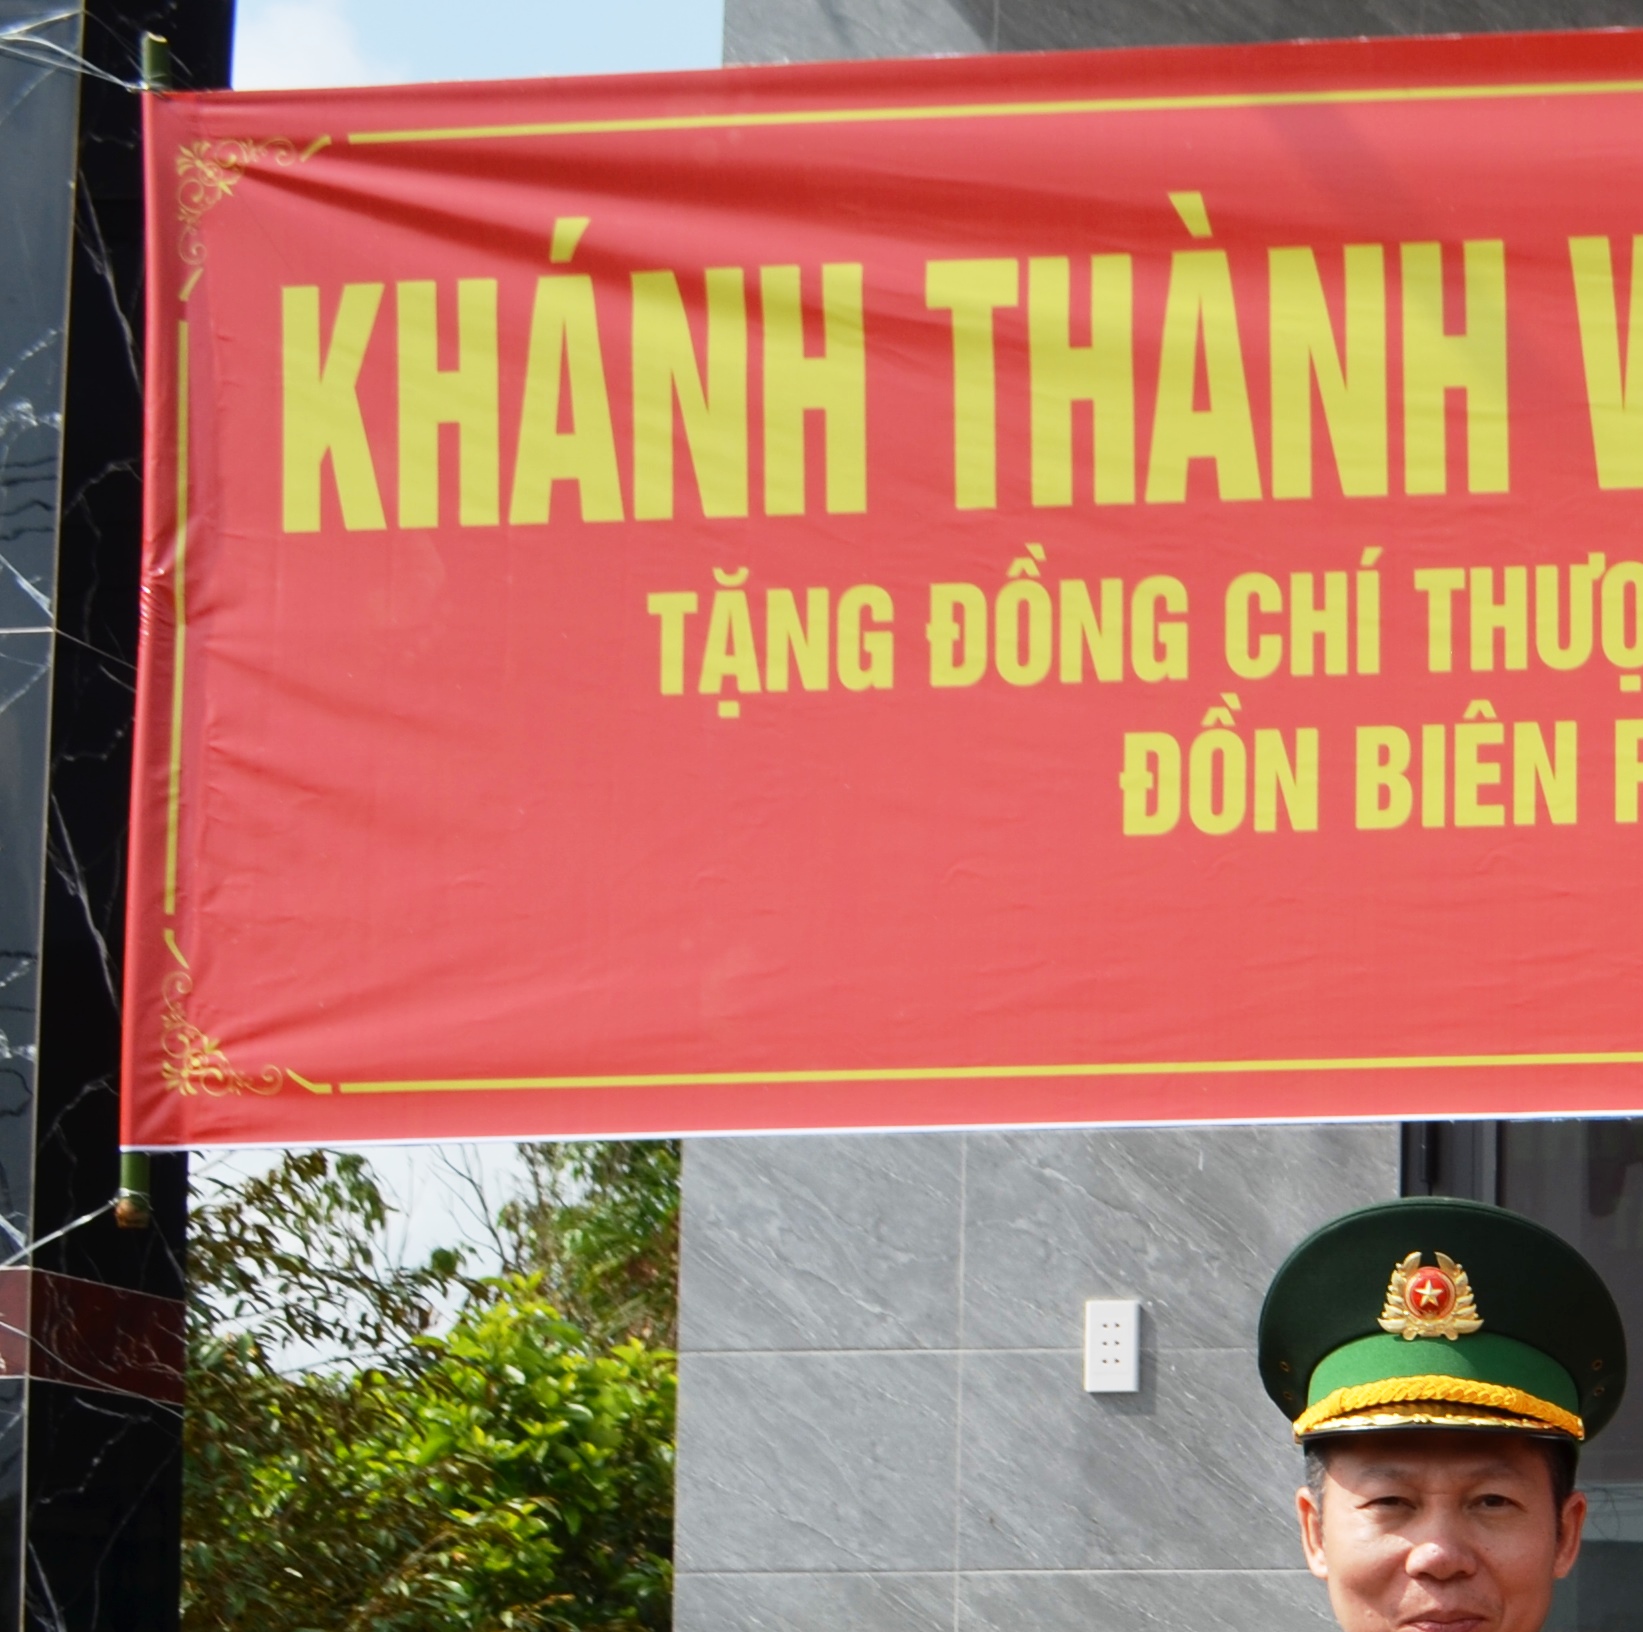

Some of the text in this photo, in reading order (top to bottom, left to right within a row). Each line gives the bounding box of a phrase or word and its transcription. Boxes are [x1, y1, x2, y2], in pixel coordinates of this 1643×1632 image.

[283, 218, 866, 532] KHÁNH
[926, 193, 1509, 508] THÀNH
[648, 569, 893, 717] TẶNG
[927, 544, 1188, 686] ĐỒNG
[1226, 548, 1380, 678] CHÍ
[1120, 693, 1318, 835] ĐỒN
[1356, 700, 1577, 829] BIÊN
